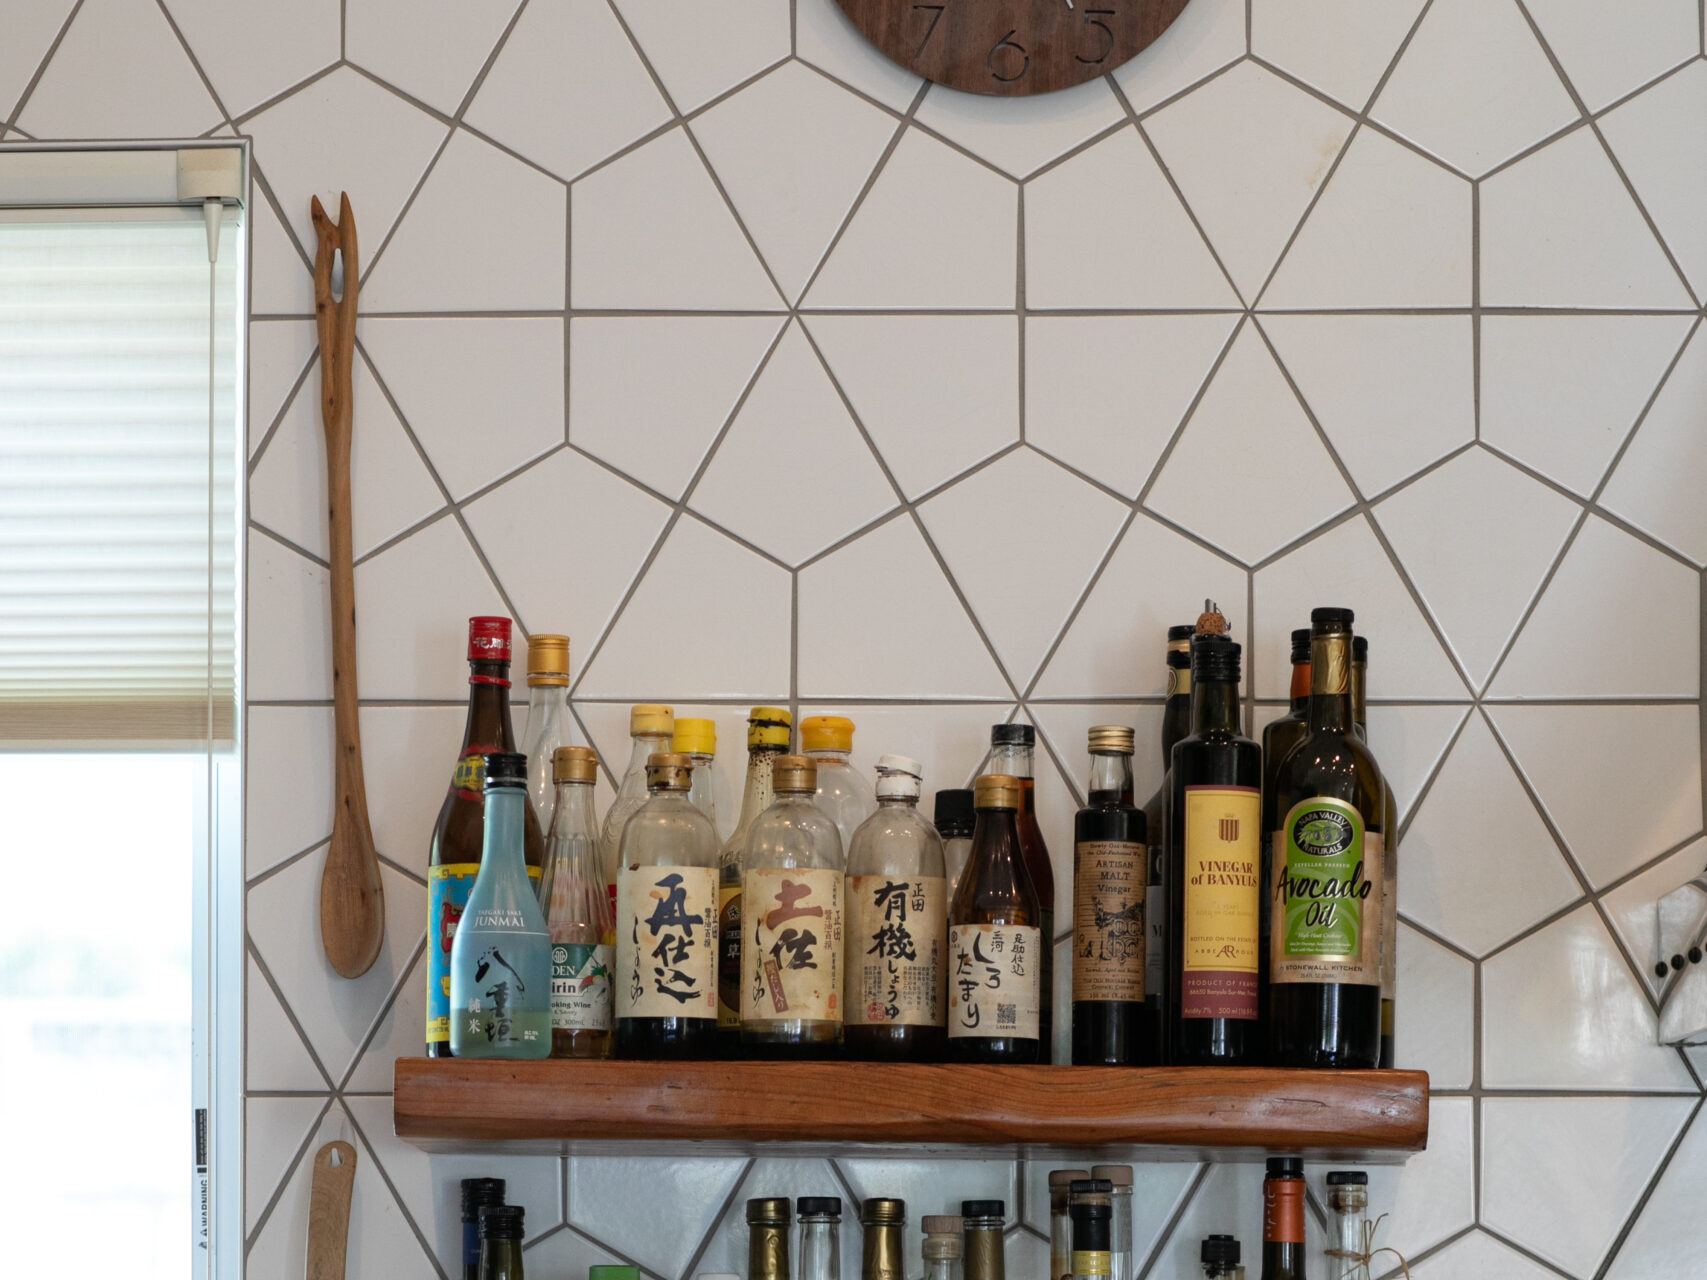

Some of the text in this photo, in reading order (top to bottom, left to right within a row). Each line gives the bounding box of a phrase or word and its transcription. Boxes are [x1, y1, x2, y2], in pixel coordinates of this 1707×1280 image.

[913, 5, 944, 58] 7
[1075, 10, 1115, 65] 5
[987, 30, 1029, 82] 6
[1299, 811, 1348, 826] NAPA VALLEY
[1302, 843, 1343, 856] NATURALS
[1095, 859, 1134, 869] ARTISAN
[1199, 861, 1253, 874] VINEGAR
[1100, 871, 1130, 881] MALT
[1191, 874, 1257, 887] of BANYULS
[1275, 860, 1372, 905] Avocado
[912, 882, 925, 912] 正田
[1096, 884, 1131, 895] Vinegar
[474, 916, 525, 927] JUNMAI
[766, 879, 823, 970] 土佐
[1305, 901, 1338, 929] Oil
[644, 873, 704, 1004] 再仕込
[991, 930, 1004, 953] 三河
[552, 965, 575, 976] DEN
[552, 982, 576, 993] irin
[956, 947, 980, 1029] たまり
[468, 998, 481, 1034] 純米
[1218, 1007, 1230, 1015] 500
